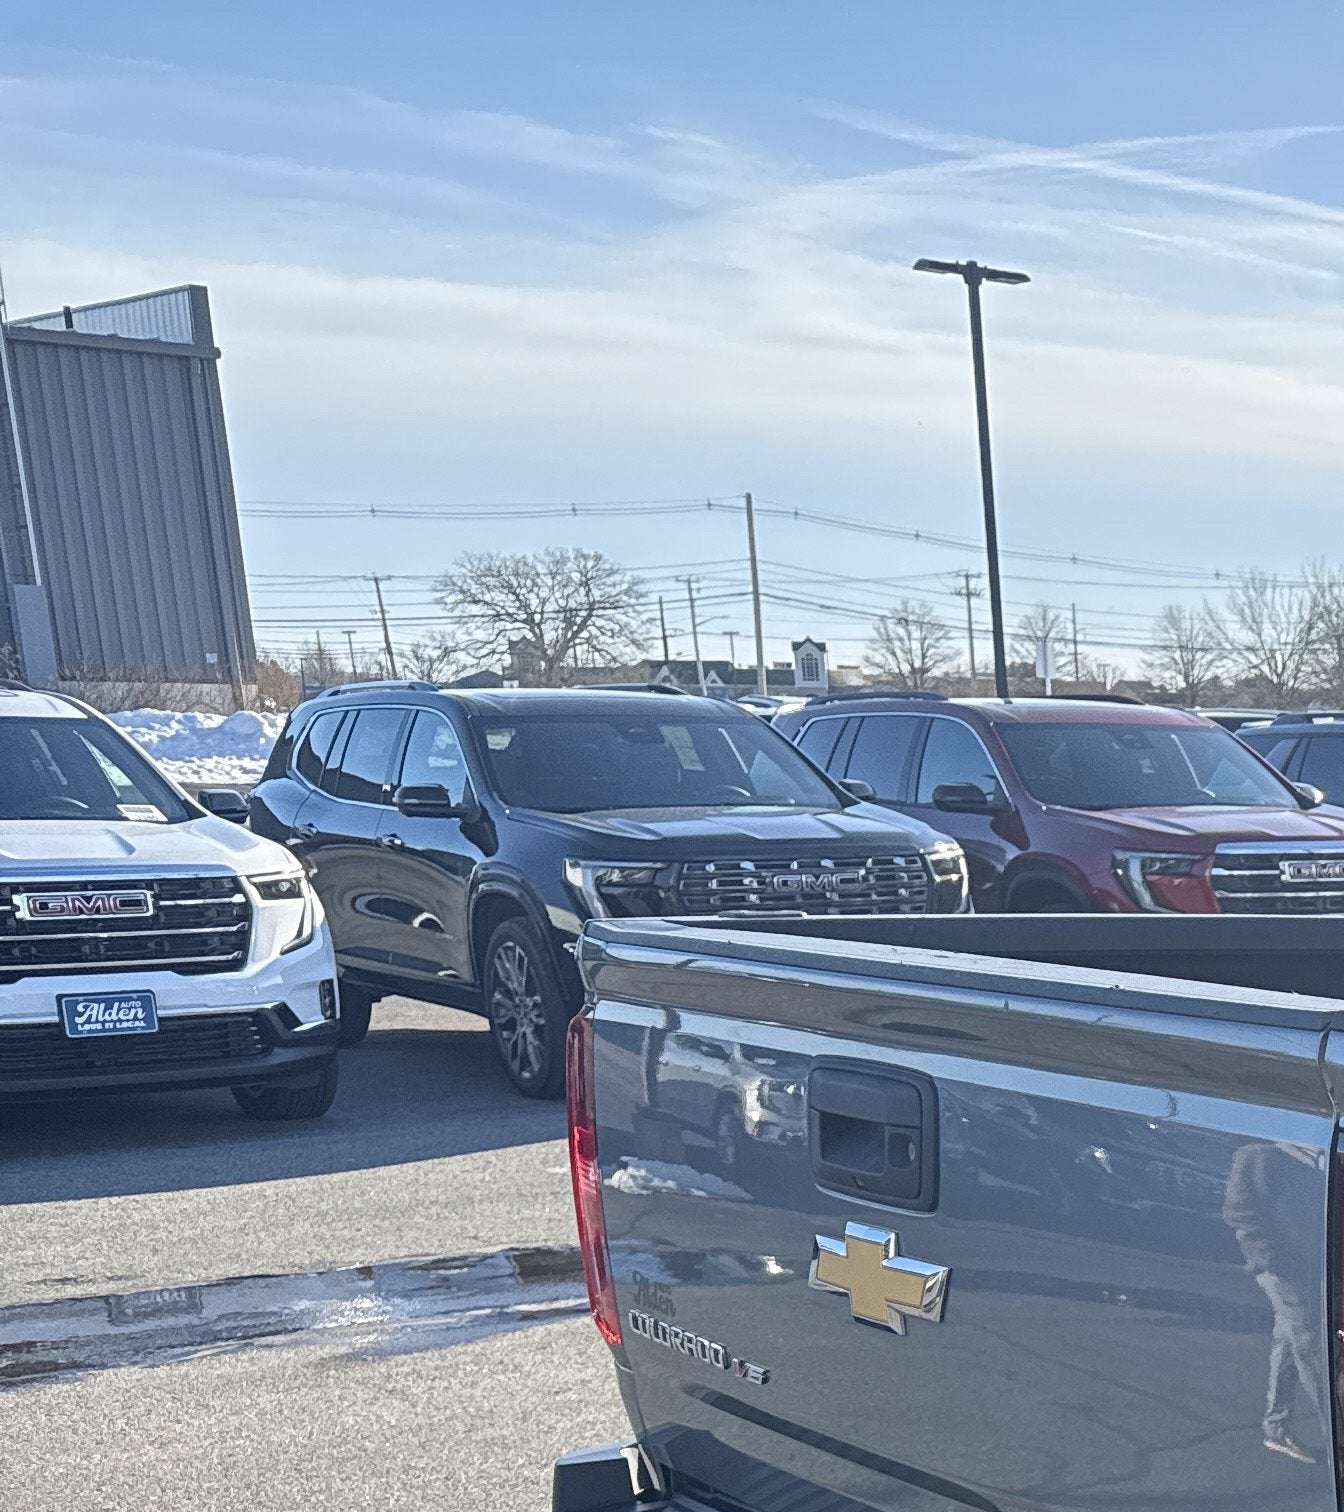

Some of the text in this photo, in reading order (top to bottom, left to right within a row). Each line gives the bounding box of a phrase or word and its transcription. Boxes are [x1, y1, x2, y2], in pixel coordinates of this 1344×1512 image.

[773, 873, 861, 892] GMC
[29, 893, 148, 918] GMC
[75, 1002, 146, 1024] Alden
[120, 1001, 141, 1009] AUTO
[78, 1023, 102, 1031] LOVE
[116, 1020, 147, 1028] LOCAL
[628, 1308, 770, 1385] COLORADO V6
